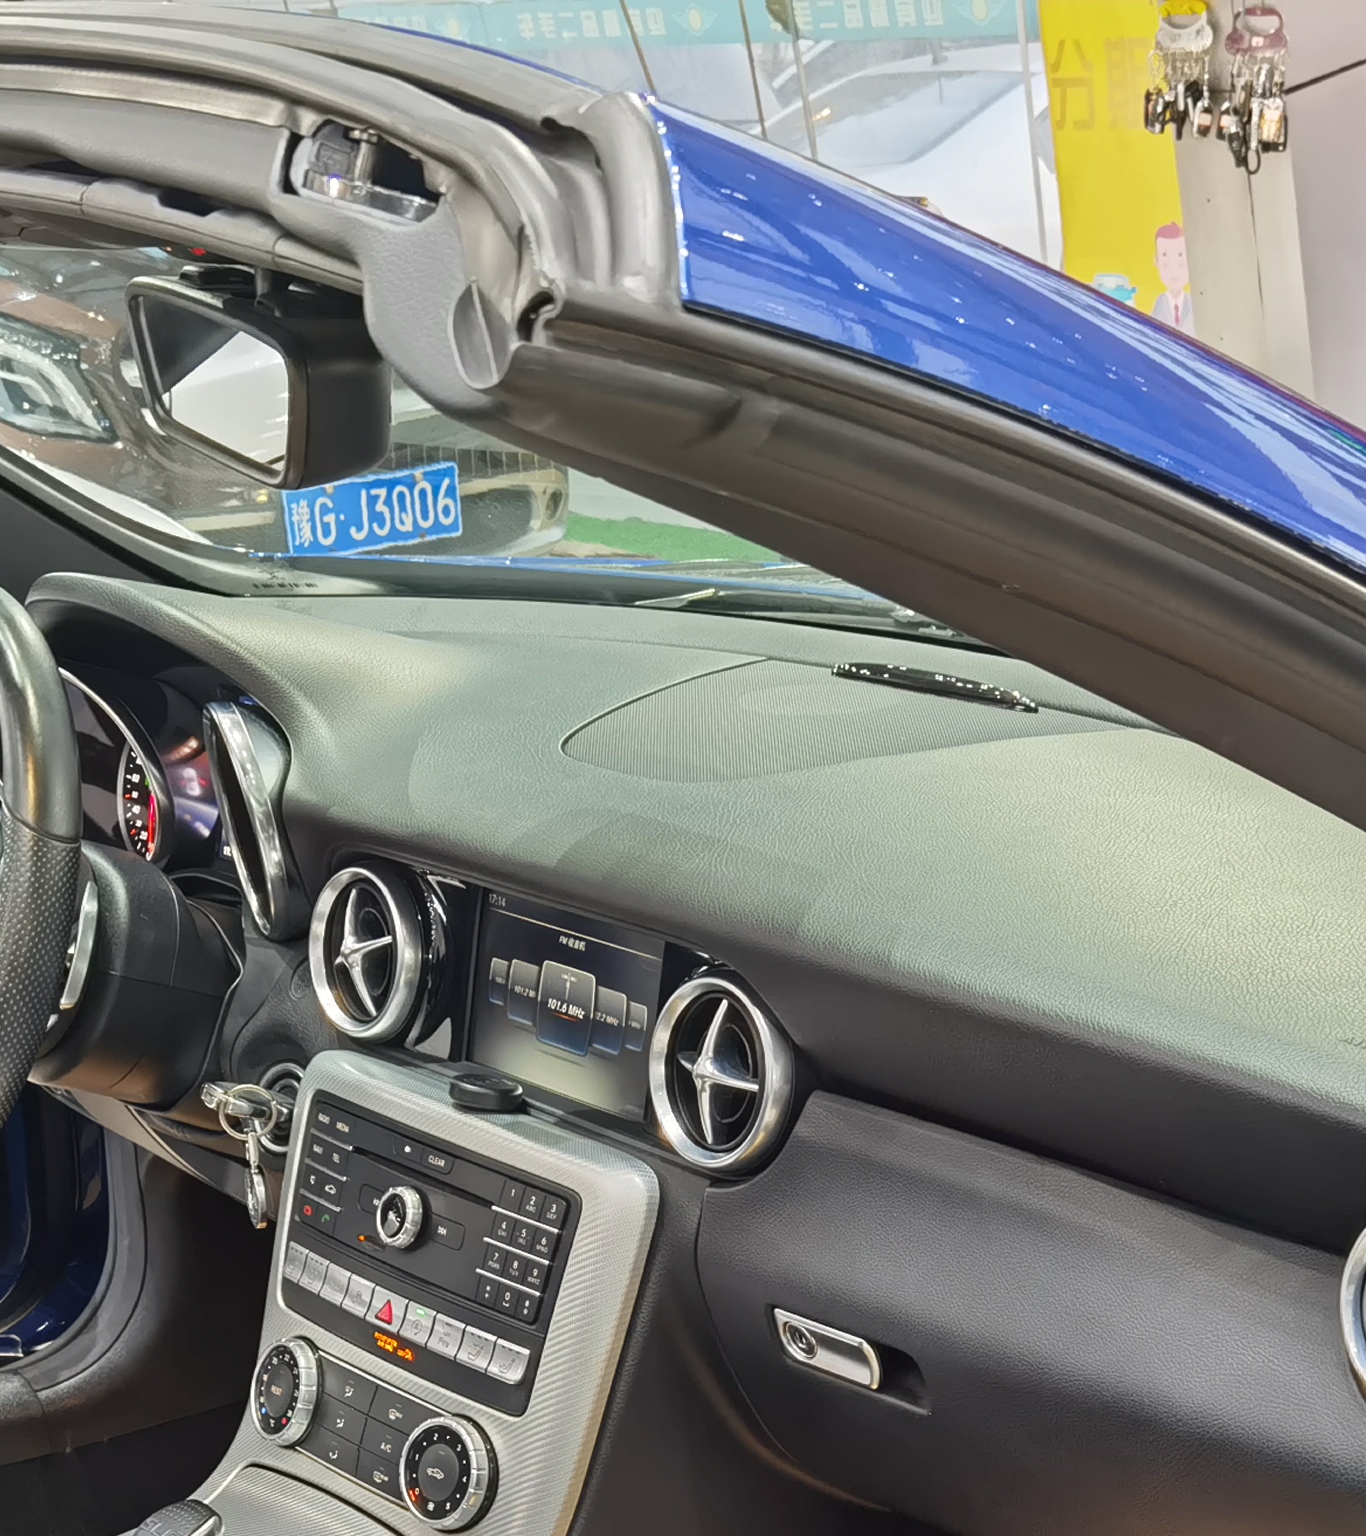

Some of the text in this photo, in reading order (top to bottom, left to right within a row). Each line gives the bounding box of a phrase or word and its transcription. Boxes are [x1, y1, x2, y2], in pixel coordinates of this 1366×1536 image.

[547, 997, 586, 1020] 101.6 MHz
[428, 1155, 446, 1168] CLEAR
